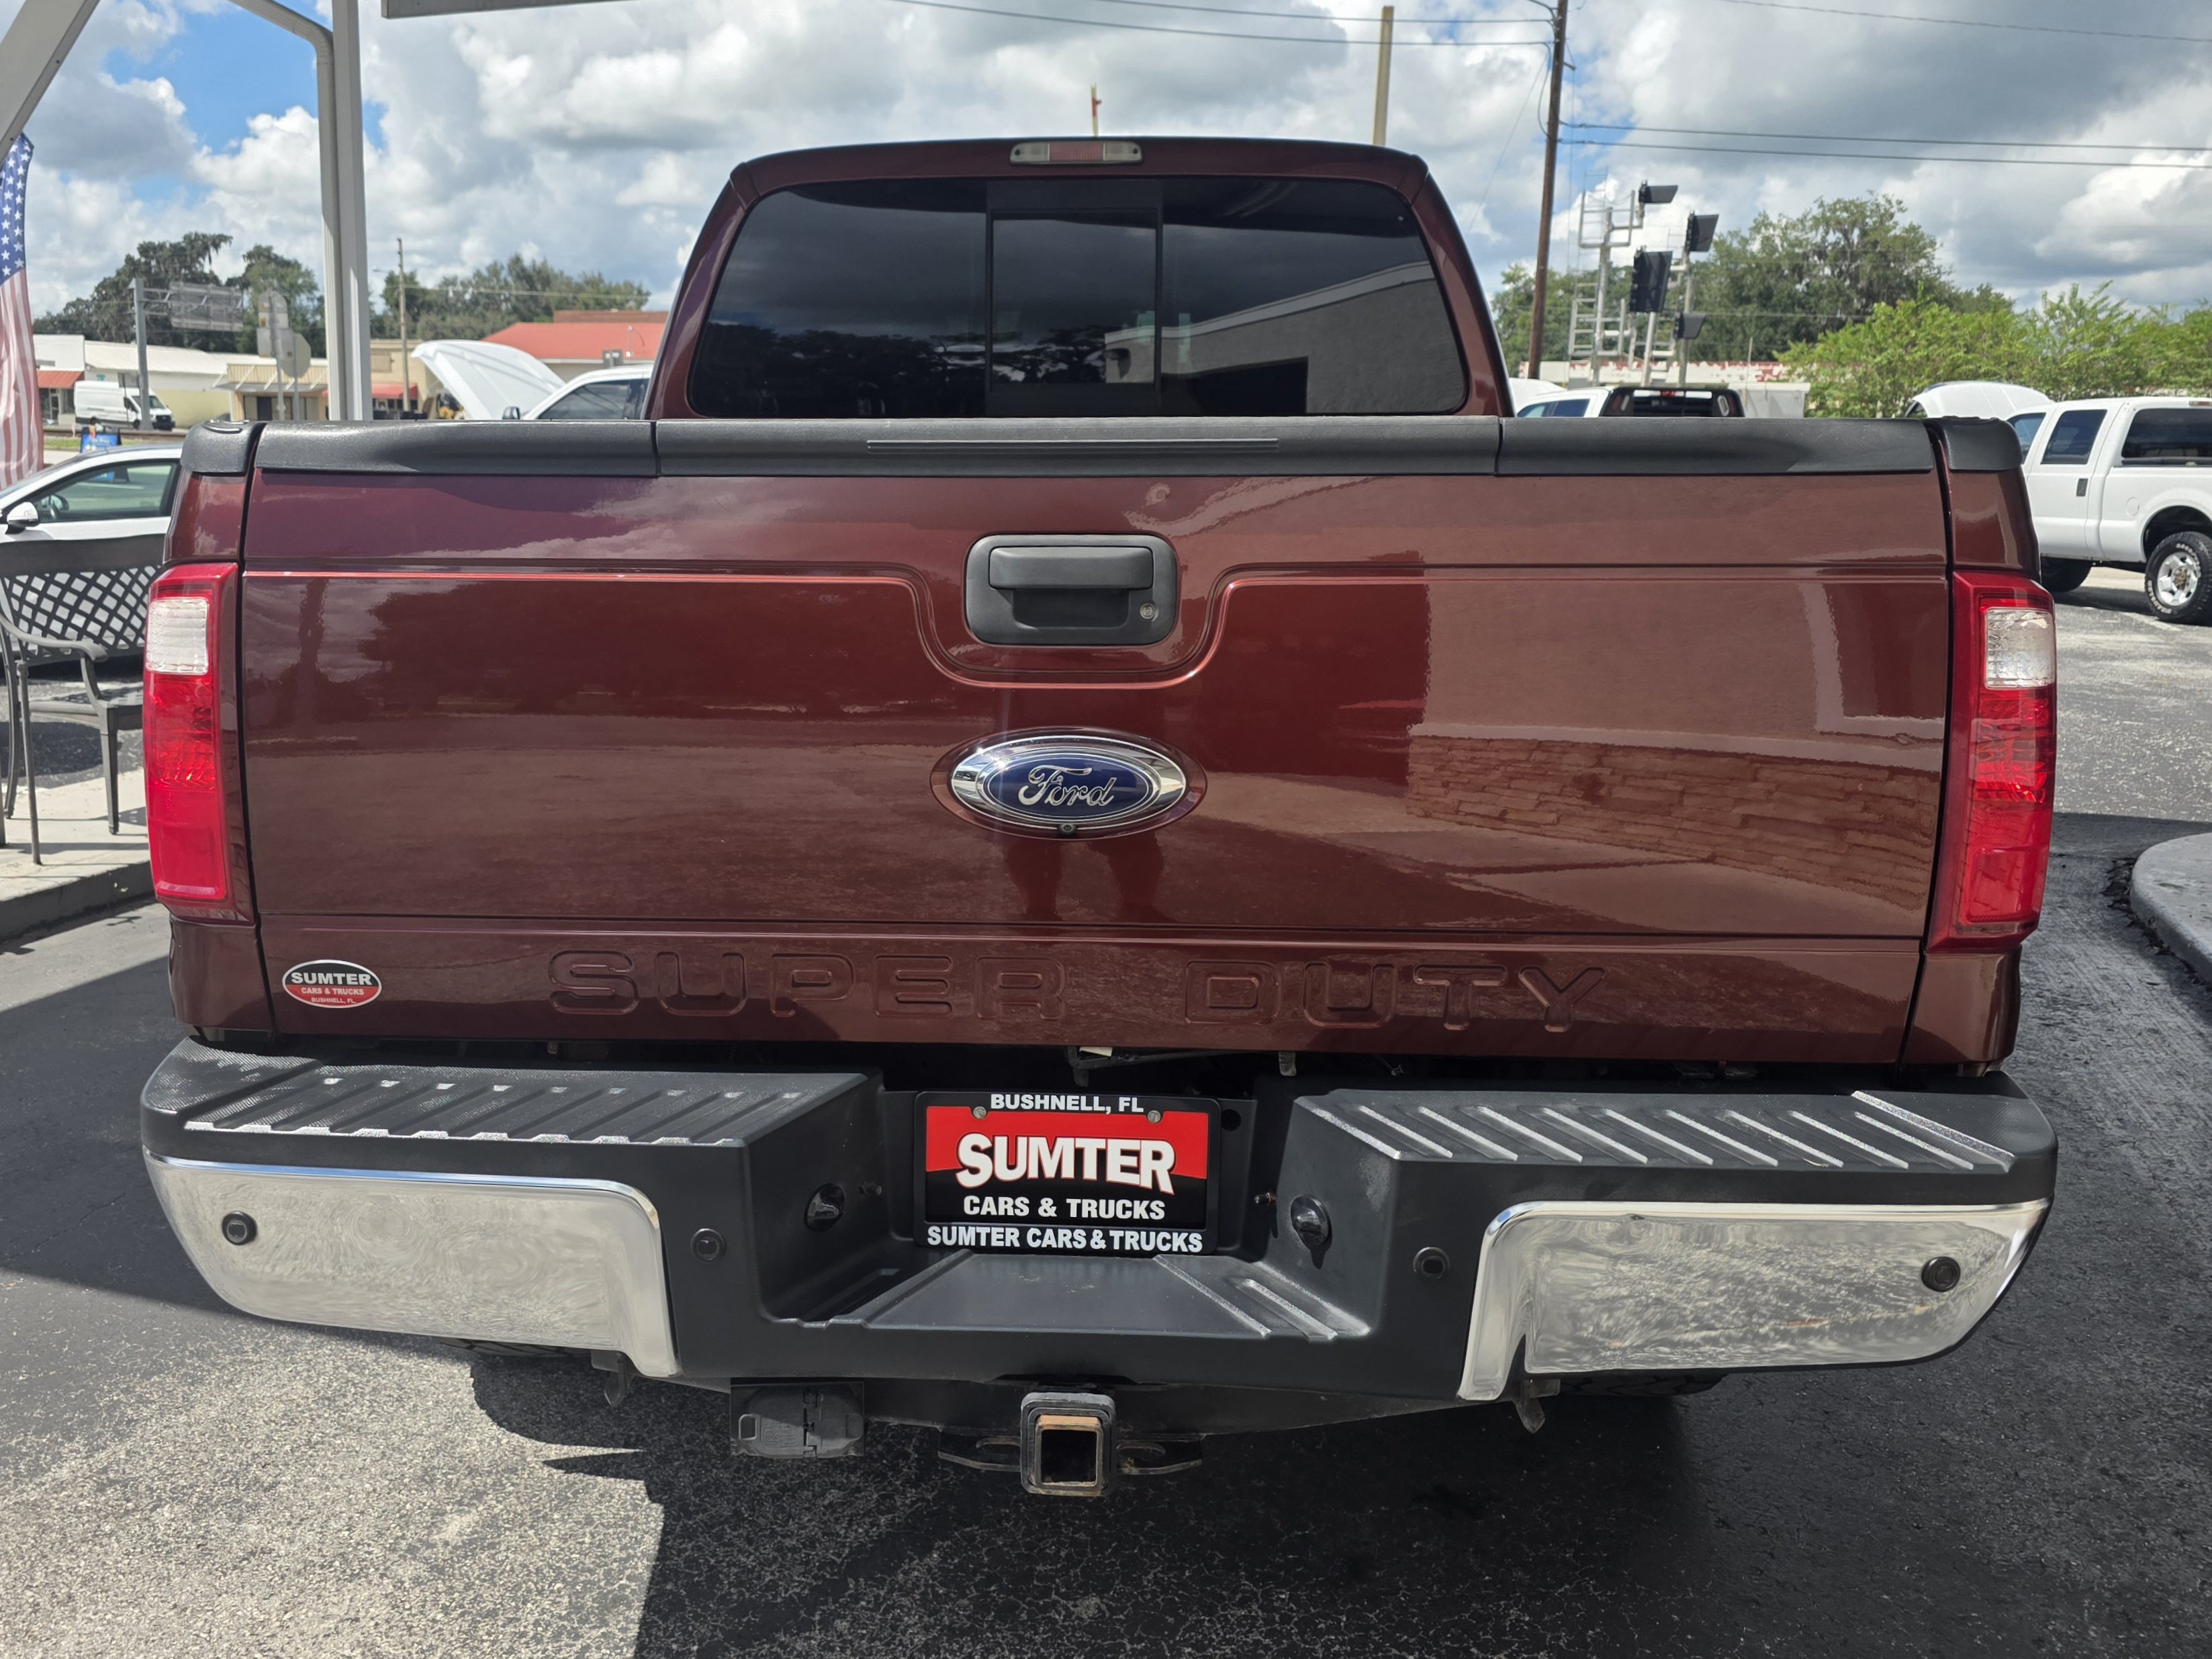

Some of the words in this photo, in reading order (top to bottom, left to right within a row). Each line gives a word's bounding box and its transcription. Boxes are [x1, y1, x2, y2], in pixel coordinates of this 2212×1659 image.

[1018, 764, 1117, 807] Ford
[291, 972, 372, 985] SUMTER
[548, 950, 1066, 1020] SUPER
[1185, 960, 1606, 1032] DUTY
[990, 1093, 1111, 1115] BUSHNELL,
[1119, 1096, 1144, 1113] FL
[955, 1132, 1177, 1196] SUMTER
[963, 1196, 1029, 1217] CARS
[1038, 1198, 1058, 1217] &
[1066, 1198, 1166, 1220] TRUCKS
[927, 1226, 1020, 1247] SUMTER
[1026, 1227, 1087, 1249] CARS
[1090, 1230, 1107, 1249] &
[1109, 1230, 1203, 1253] TRUCKS
